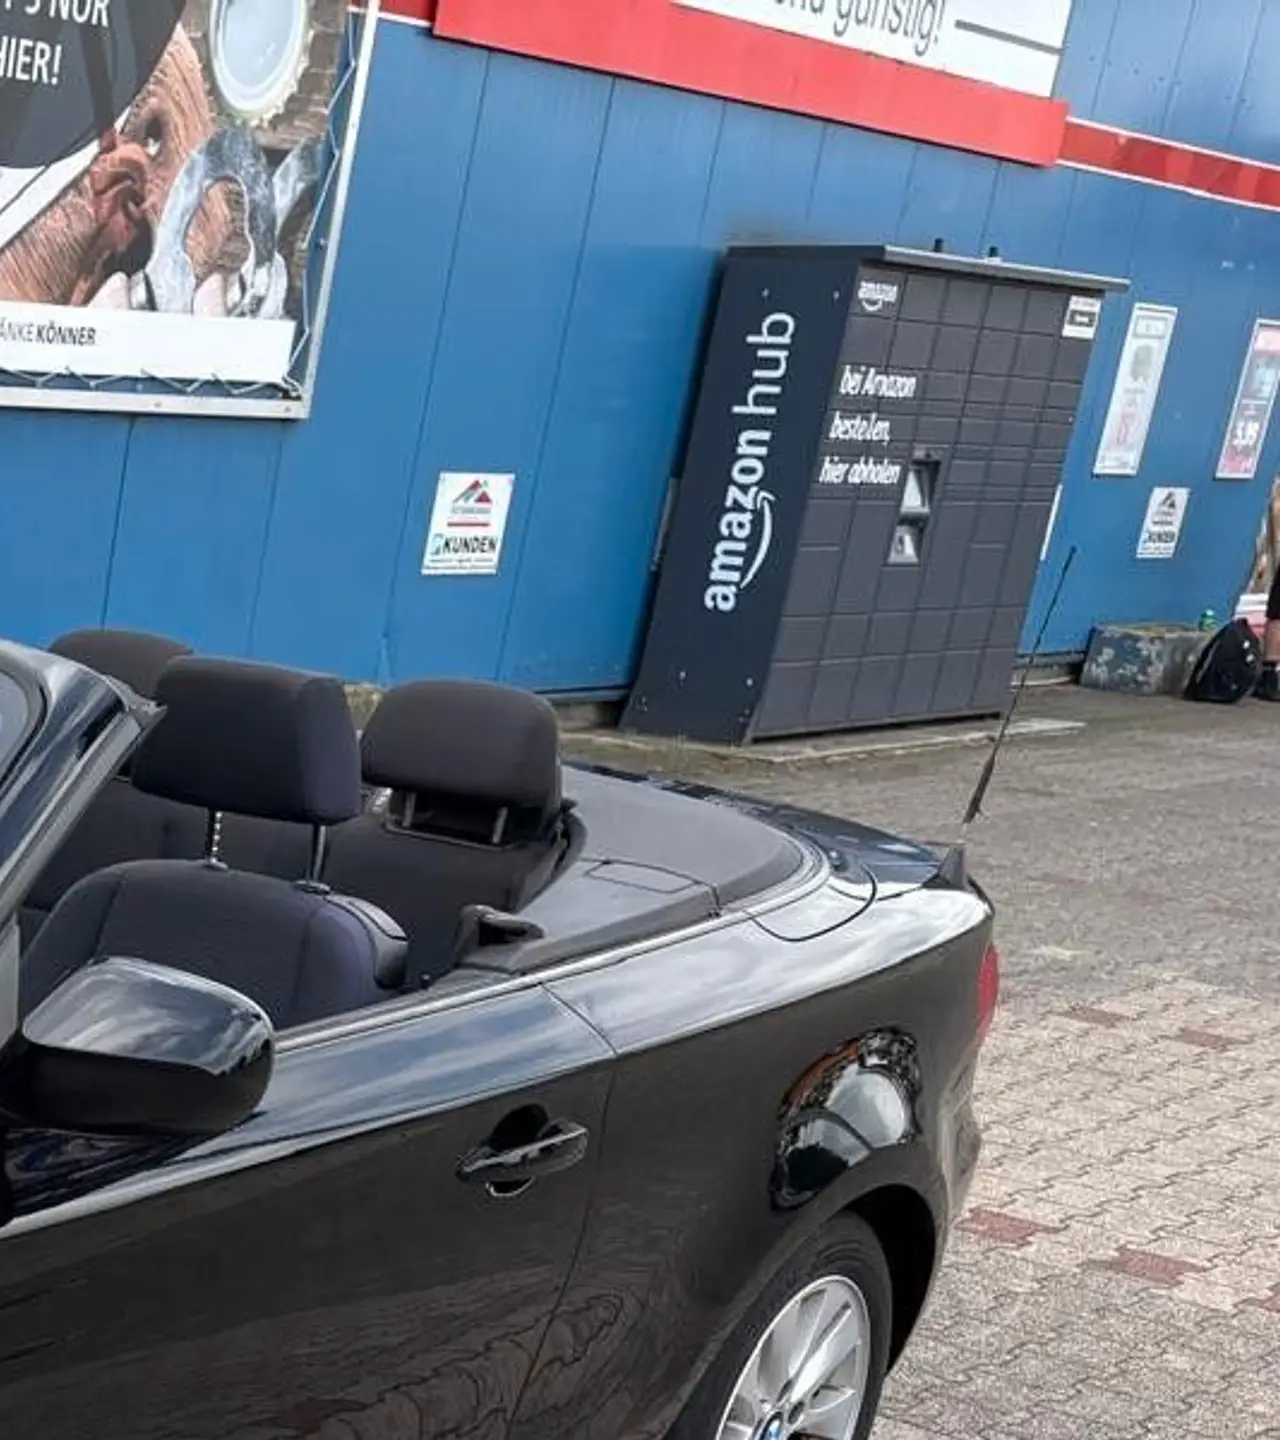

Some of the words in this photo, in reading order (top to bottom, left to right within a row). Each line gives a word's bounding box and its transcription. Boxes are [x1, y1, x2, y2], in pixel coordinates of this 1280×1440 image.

[731, 312, 796, 415] hub
[839, 365, 866, 395] bei
[819, 455, 849, 484] hier
[703, 429, 775, 613] amazon
[443, 535, 497, 554] KUNDEN
